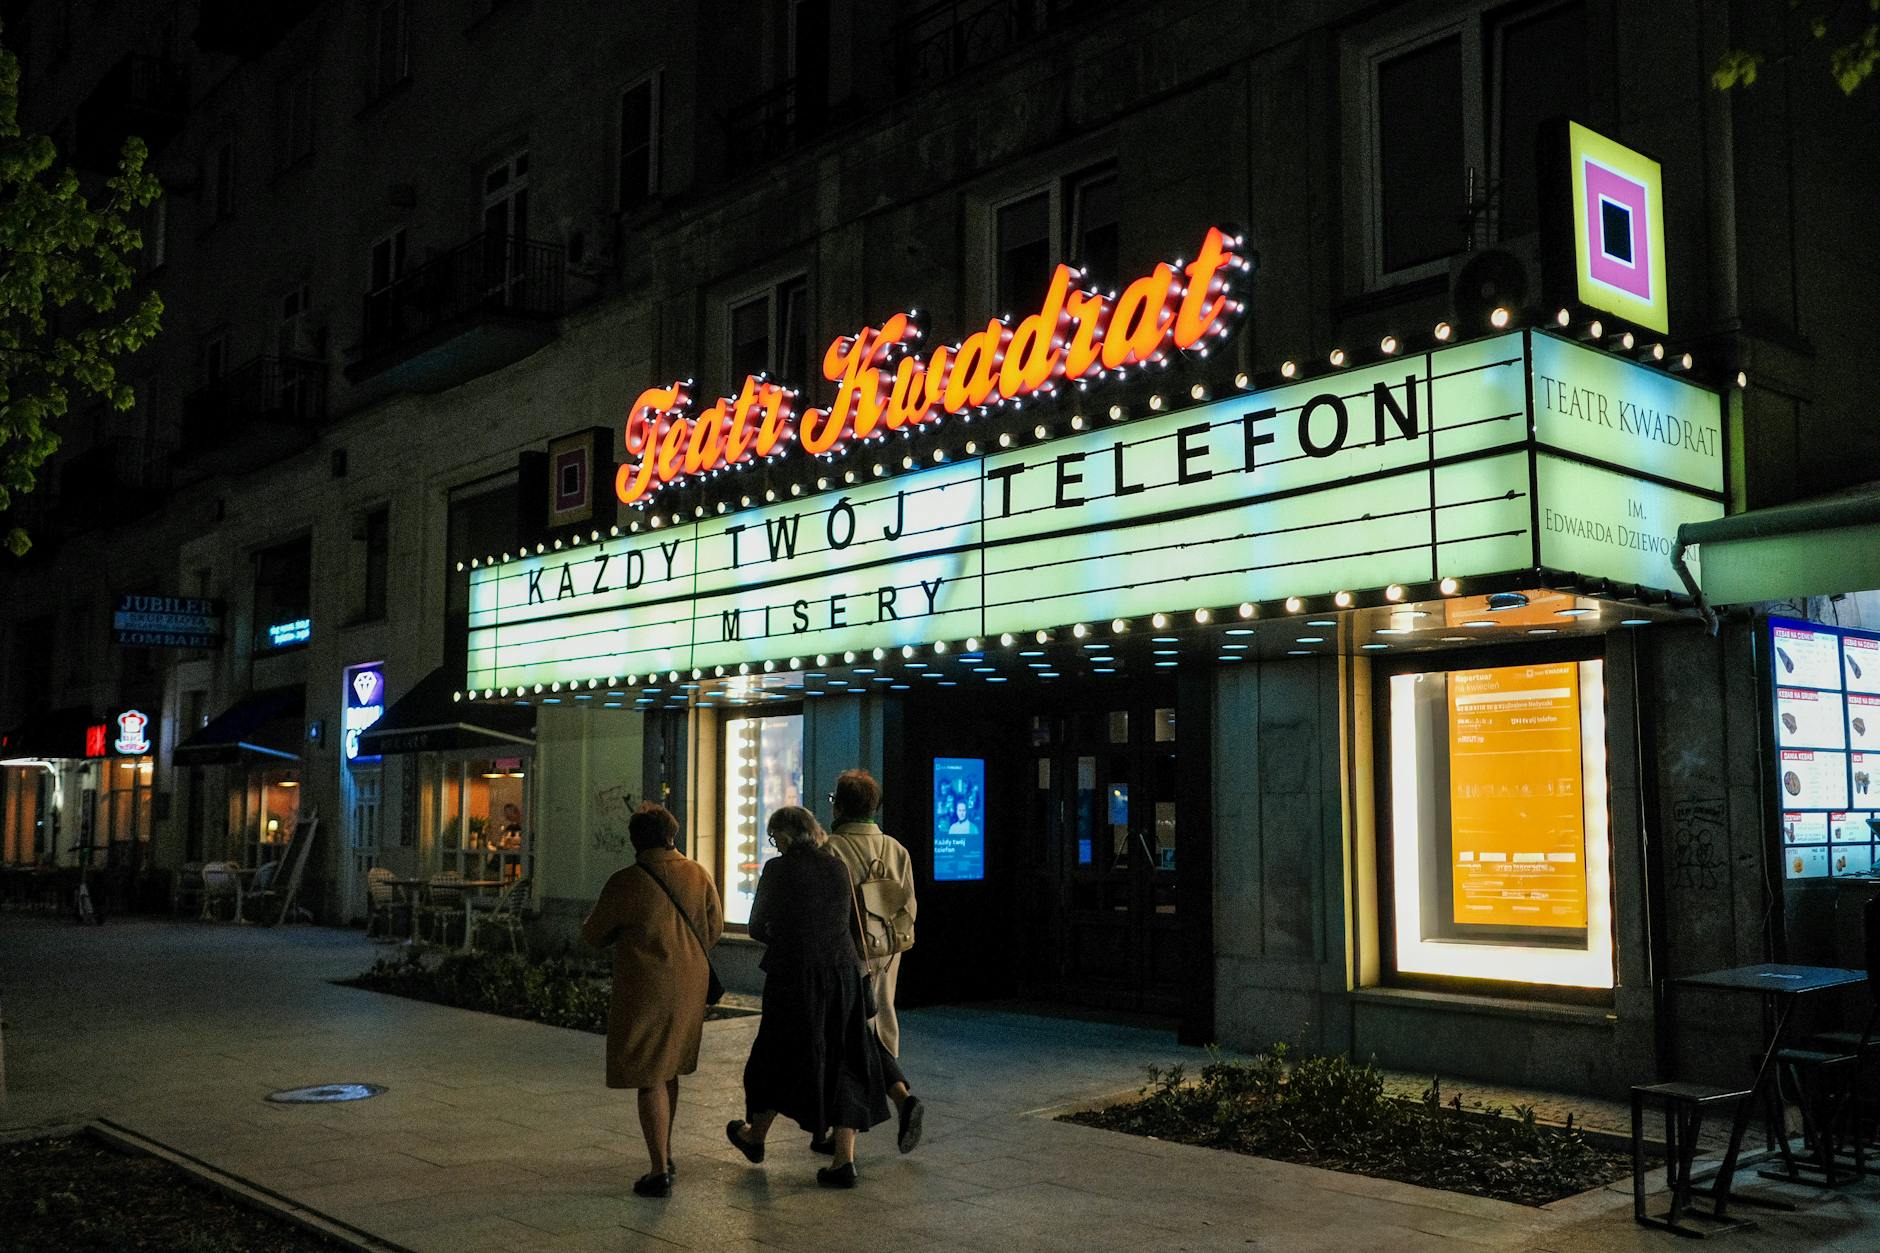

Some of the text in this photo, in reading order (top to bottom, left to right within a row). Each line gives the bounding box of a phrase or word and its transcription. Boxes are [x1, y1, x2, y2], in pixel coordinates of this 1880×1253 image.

[615, 226, 1236, 505] Teatr Kwadrat
[1540, 375, 1718, 458] TEATR KWADRAT
[528, 375, 1420, 606] KAŻDY TWÓJ TELEFON
[1627, 499, 1647, 520] IM.
[1545, 508, 1614, 545] EDWARDA
[121, 595, 214, 615] JUBILER
[721, 577, 945, 642] MISERY
